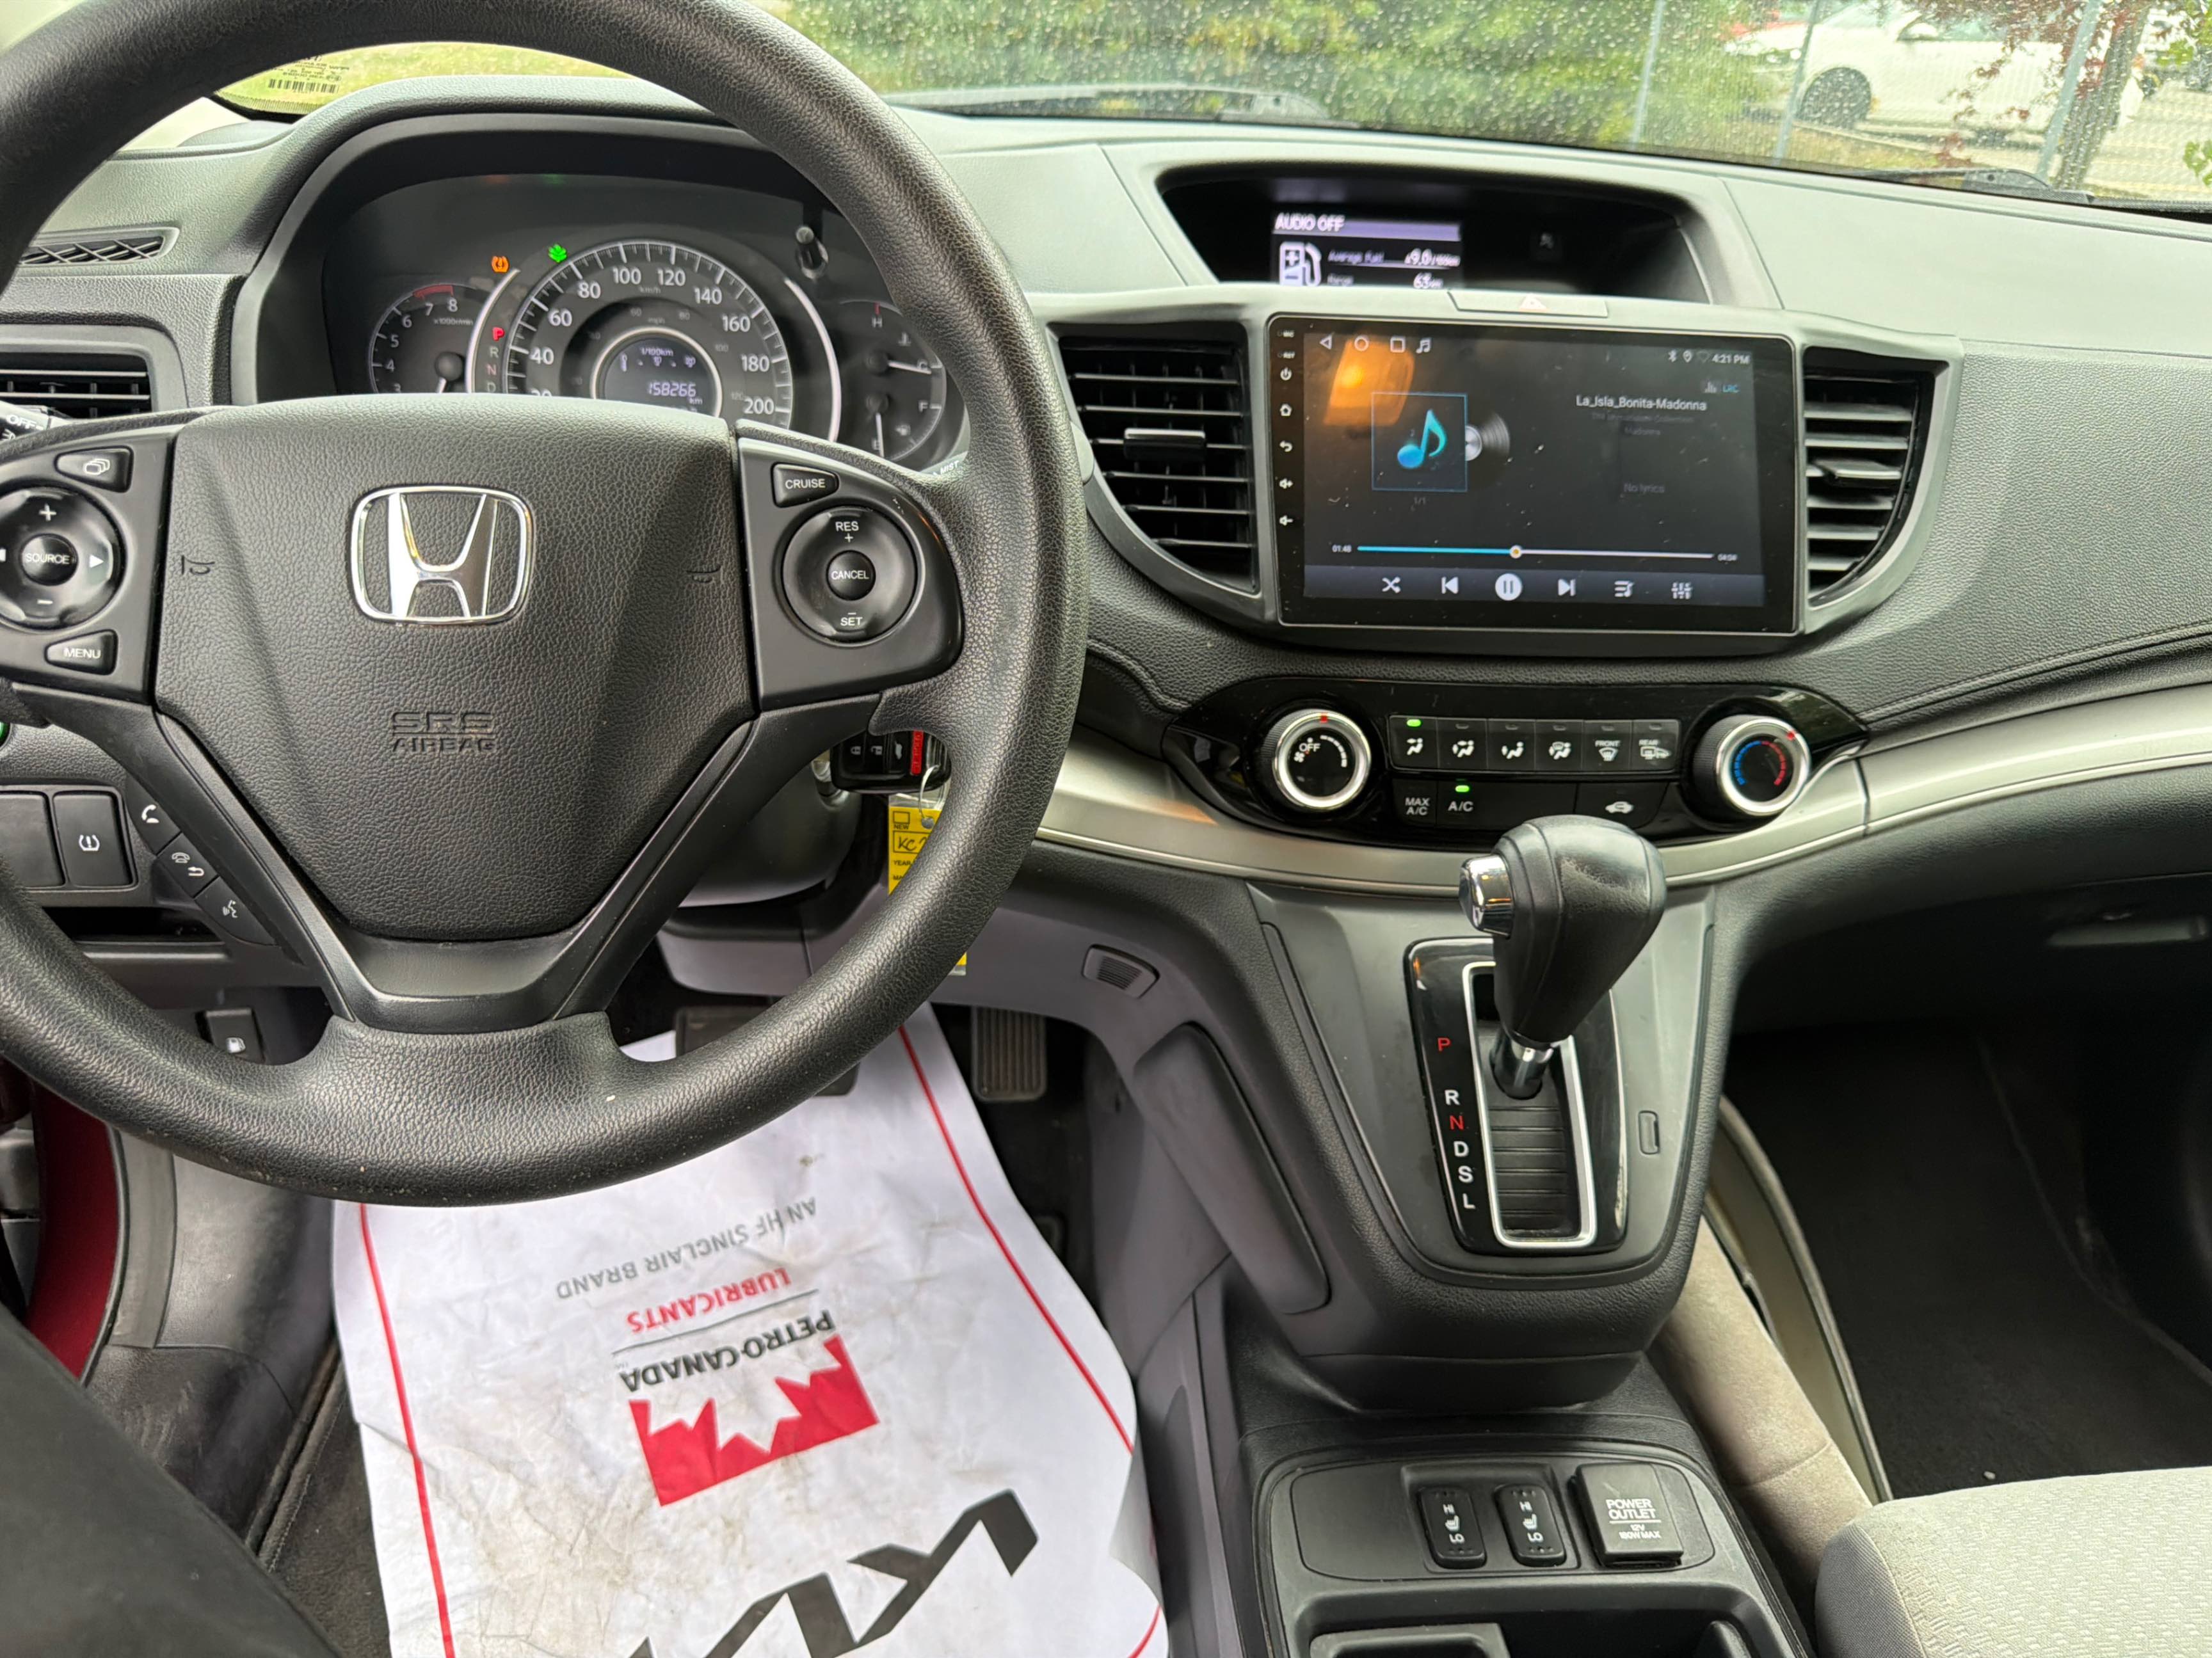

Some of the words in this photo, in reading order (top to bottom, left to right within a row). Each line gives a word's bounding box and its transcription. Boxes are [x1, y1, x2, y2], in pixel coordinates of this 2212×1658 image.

[1274, 212, 1316, 231] AUDIO
[1317, 214, 1345, 232] OFF
[613, 267, 641, 285] 100
[657, 269, 686, 286] 120
[578, 282, 601, 299] 80
[694, 287, 723, 305] 140
[425, 303, 435, 316] 7
[447, 298, 458, 312] 8
[402, 315, 412, 328] 6
[549, 310, 572, 327] 60
[722, 315, 751, 333] 160
[872, 317, 883, 328] H
[492, 327, 505, 341] P
[390, 336, 399, 348] 5
[490, 346, 499, 358] R
[529, 348, 554, 365] 40
[1711, 354, 1731, 363] 4:21
[1733, 355, 1751, 364] PM
[386, 359, 395, 372] 4
[487, 364, 497, 376] N
[741, 355, 770, 372] 180
[487, 382, 497, 392] D
[648, 381, 696, 397] 158266
[744, 397, 774, 415] 200
[918, 400, 928, 412] F
[940, 460, 960, 475] MIST
[785, 479, 826, 490] CRUISE
[835, 521, 859, 532] RES
[25, 552, 70, 565] SOURCE
[831, 570, 869, 580] CANCEL
[840, 616, 863, 626] SET
[63, 647, 102, 659] MENU
[392, 712, 495, 732] SRS
[392, 737, 498, 753] AIRBAG
[1299, 742, 1321, 753] OFF
[1405, 797, 1431, 806] MAX
[1447, 801, 1474, 812] A/C
[1406, 806, 1428, 816] A/C
[1438, 1037, 1451, 1052] P
[1445, 1090, 1460, 1105] R
[1449, 1115, 1464, 1131] N
[1454, 1142, 1470, 1157] D
[1458, 1165, 1474, 1183] S
[1463, 1193, 1476, 1209] L
[788, 1197, 817, 1225] AN
[756, 1211, 785, 1239] HF
[645, 1223, 751, 1275] SINCLAIR
[556, 1261, 639, 1300] BRAND
[625, 1266, 793, 1335] LUBRICANTS
[1443, 1504, 1455, 1515] HI
[1519, 1501, 1533, 1512] HI
[1605, 1498, 1653, 1509] POWER
[1608, 1508, 1656, 1520] OUTLET
[1640, 1530, 1662, 1539] MAX
